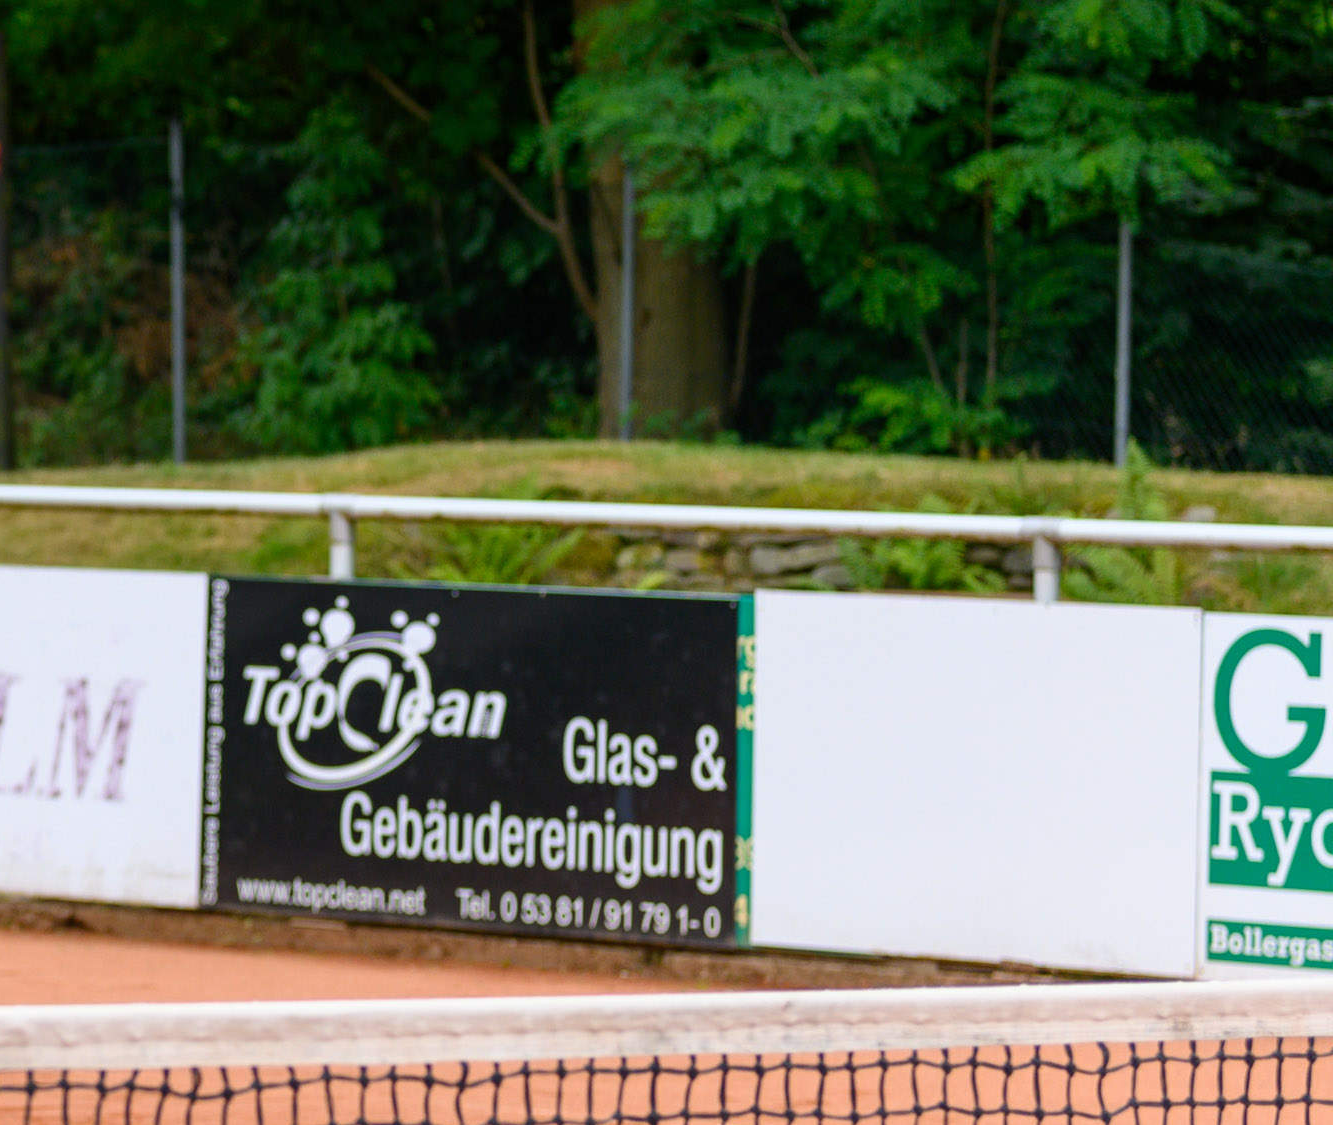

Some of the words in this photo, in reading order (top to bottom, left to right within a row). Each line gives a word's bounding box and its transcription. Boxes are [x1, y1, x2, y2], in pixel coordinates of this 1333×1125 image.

[207, 578, 231, 681] Erfahrung
[206, 682, 225, 724] aus
[242, 652, 508, 753] TopClean
[203, 725, 227, 815] Leistung
[561, 715, 678, 789] Glas-
[690, 724, 728, 792] &
[339, 790, 725, 895] Gebäudereinigung
[236, 876, 426, 916] www.topclean.net
[455, 887, 496, 921] Tel.
